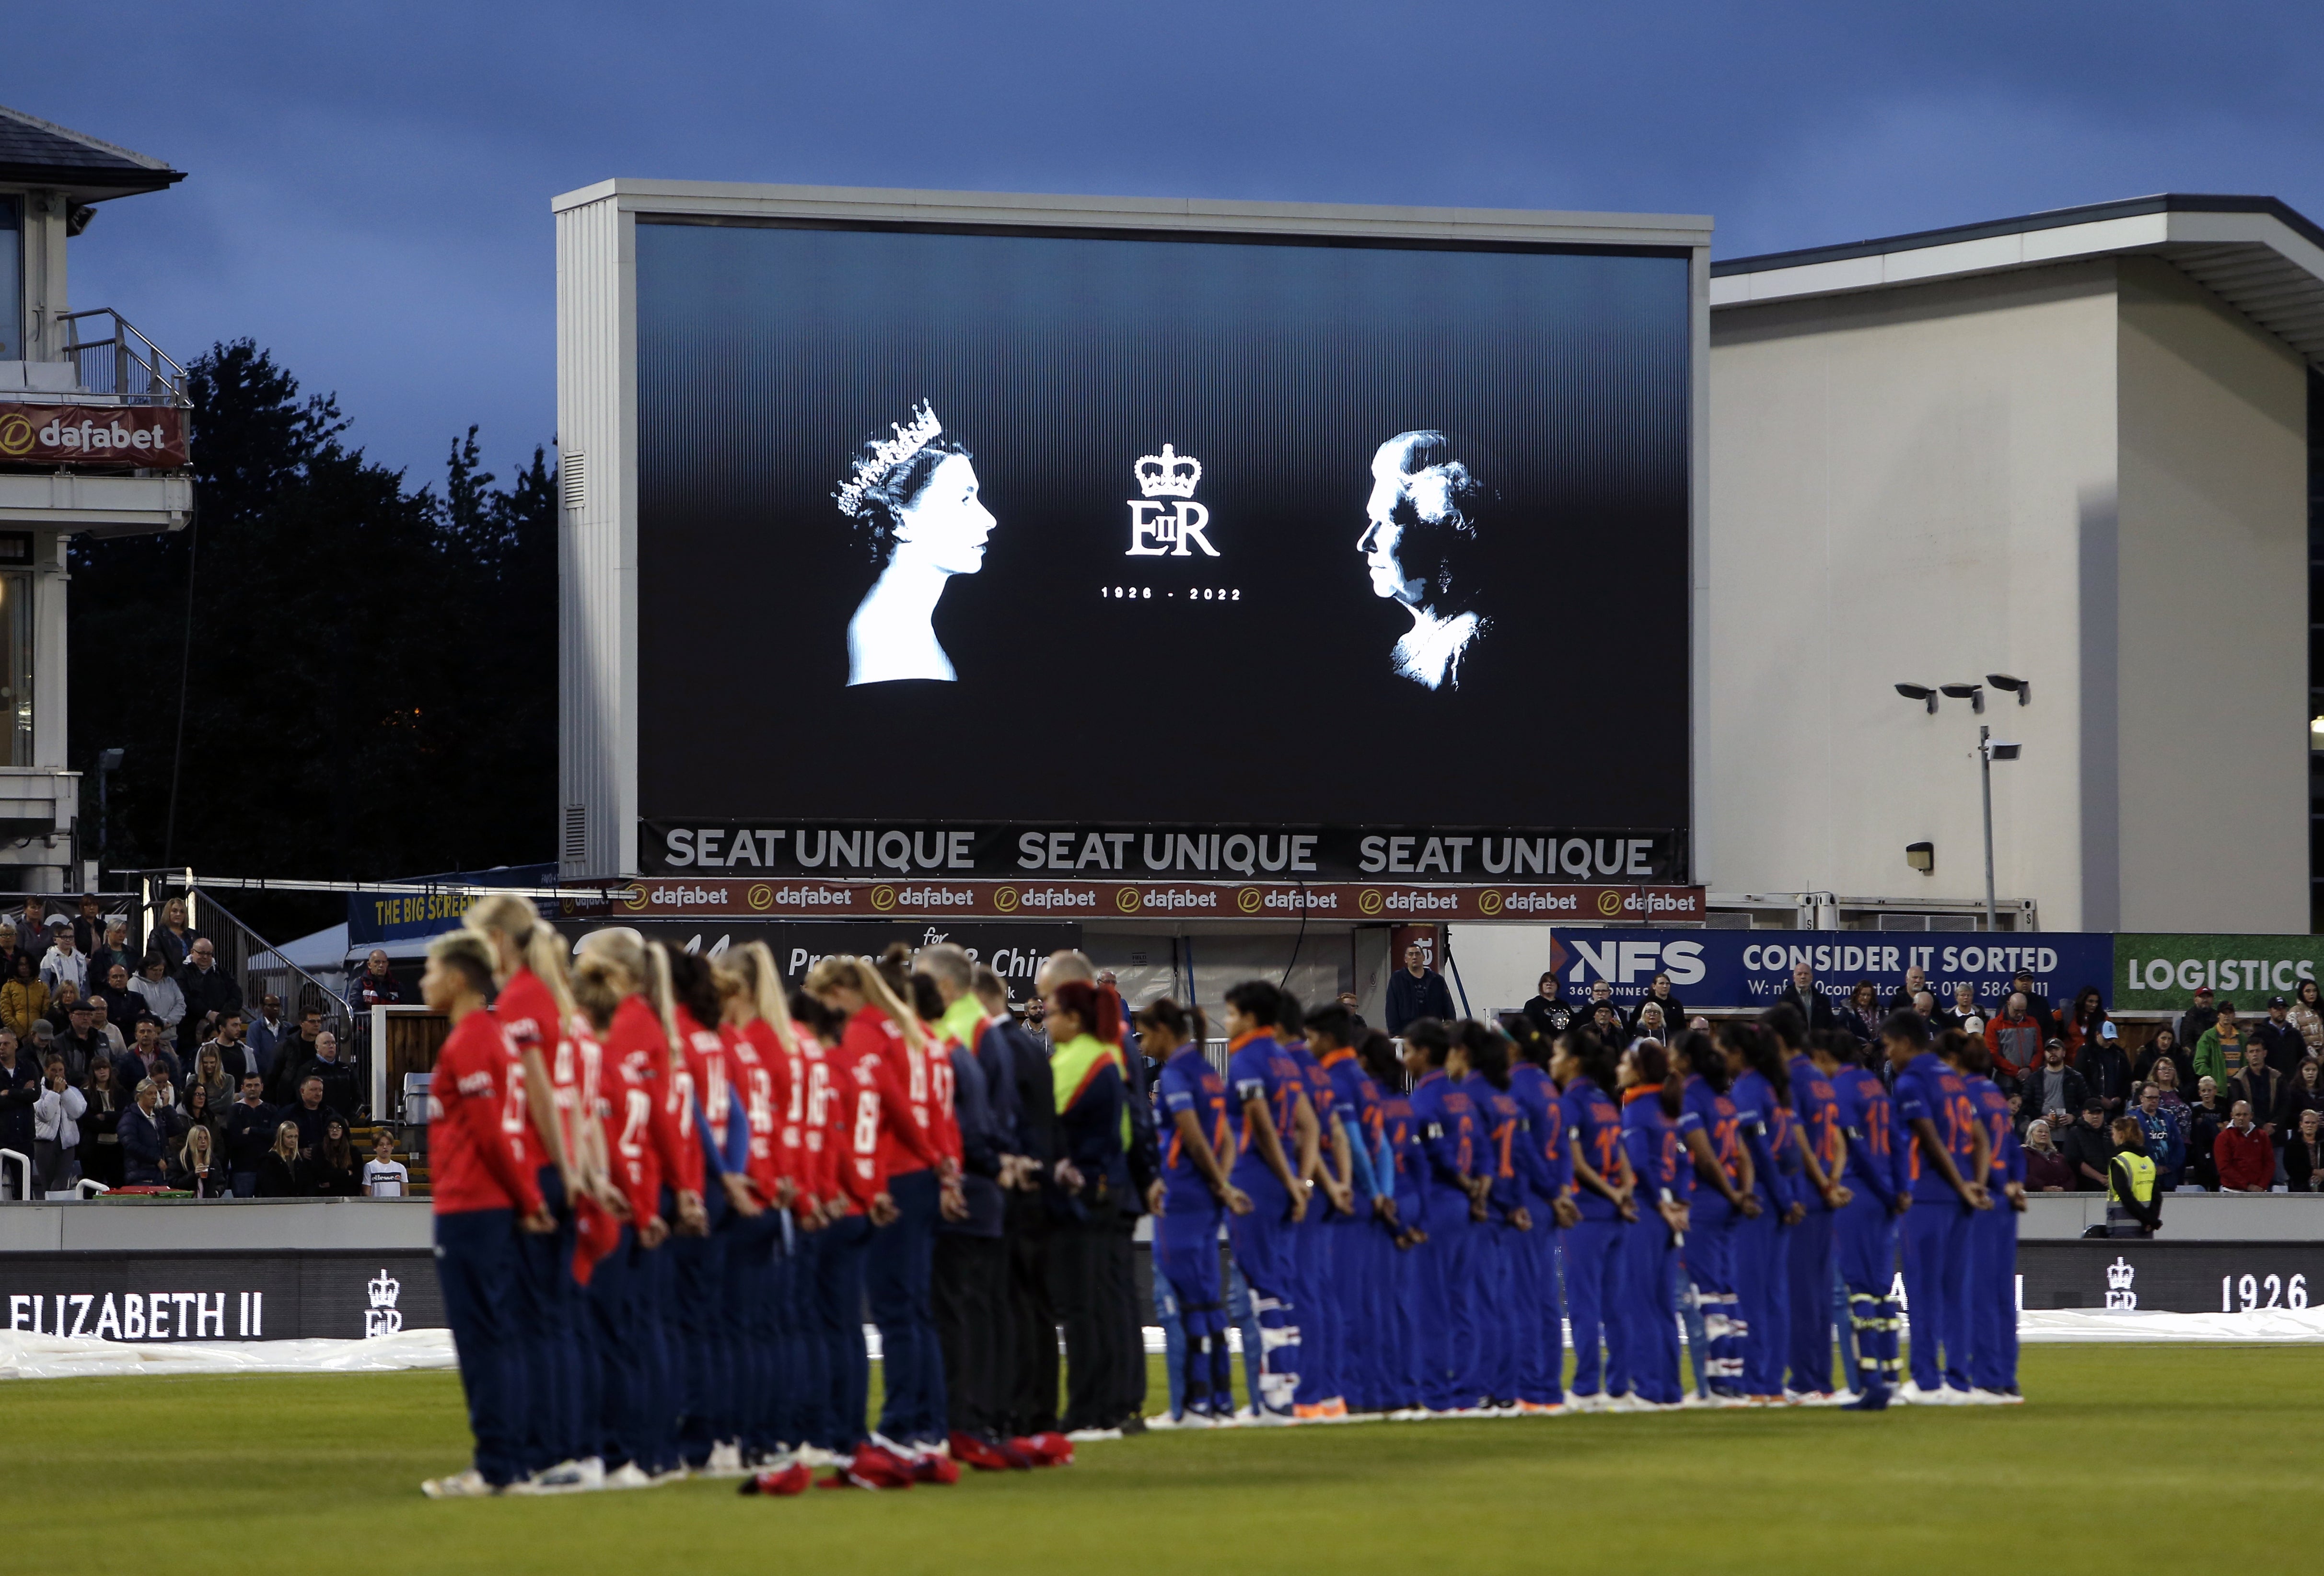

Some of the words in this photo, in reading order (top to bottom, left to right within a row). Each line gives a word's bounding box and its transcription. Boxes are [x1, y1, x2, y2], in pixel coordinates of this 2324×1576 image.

[39, 418, 164, 452] dafabet
[1102, 587, 1151, 599] 1926
[1190, 588, 1240, 600] 2022
[664, 828, 785, 866] SEAT
[796, 830, 975, 874] UNIQUE
[1017, 832, 1134, 869] SEAT
[1143, 833, 1318, 877] UNIQUE
[1359, 835, 1473, 873] SEAT
[1482, 837, 1653, 880] UNIQUE
[651, 886, 728, 907] dafabet
[775, 886, 852, 908] dafabet
[898, 887, 974, 908] dafabet
[1021, 888, 1096, 910] dafabet
[1143, 889, 1217, 910] dafabet
[1264, 890, 1337, 910] dafabet
[1385, 891, 1458, 912] dafabet
[1505, 892, 1577, 912] dafabet
[1624, 893, 1696, 913] dafabet
[375, 899, 400, 926] THE
[404, 896, 425, 922] BIG
[924, 927, 949, 946] for
[991, 948, 1051, 984] Chip
[1569, 941, 1706, 985] NFS
[1743, 945, 1901, 972] CONSIDER
[1910, 947, 1935, 972] IT
[1942, 947, 2057, 973] SORTED
[2129, 959, 2315, 991] LOGISTICS
[1748, 980, 1768, 995] W:
[1980, 982, 2011, 996] 586
[2222, 1273, 2308, 1312] 1926
[9, 1292, 225, 1339] ELIZABETH
[239, 1291, 263, 1337] II
